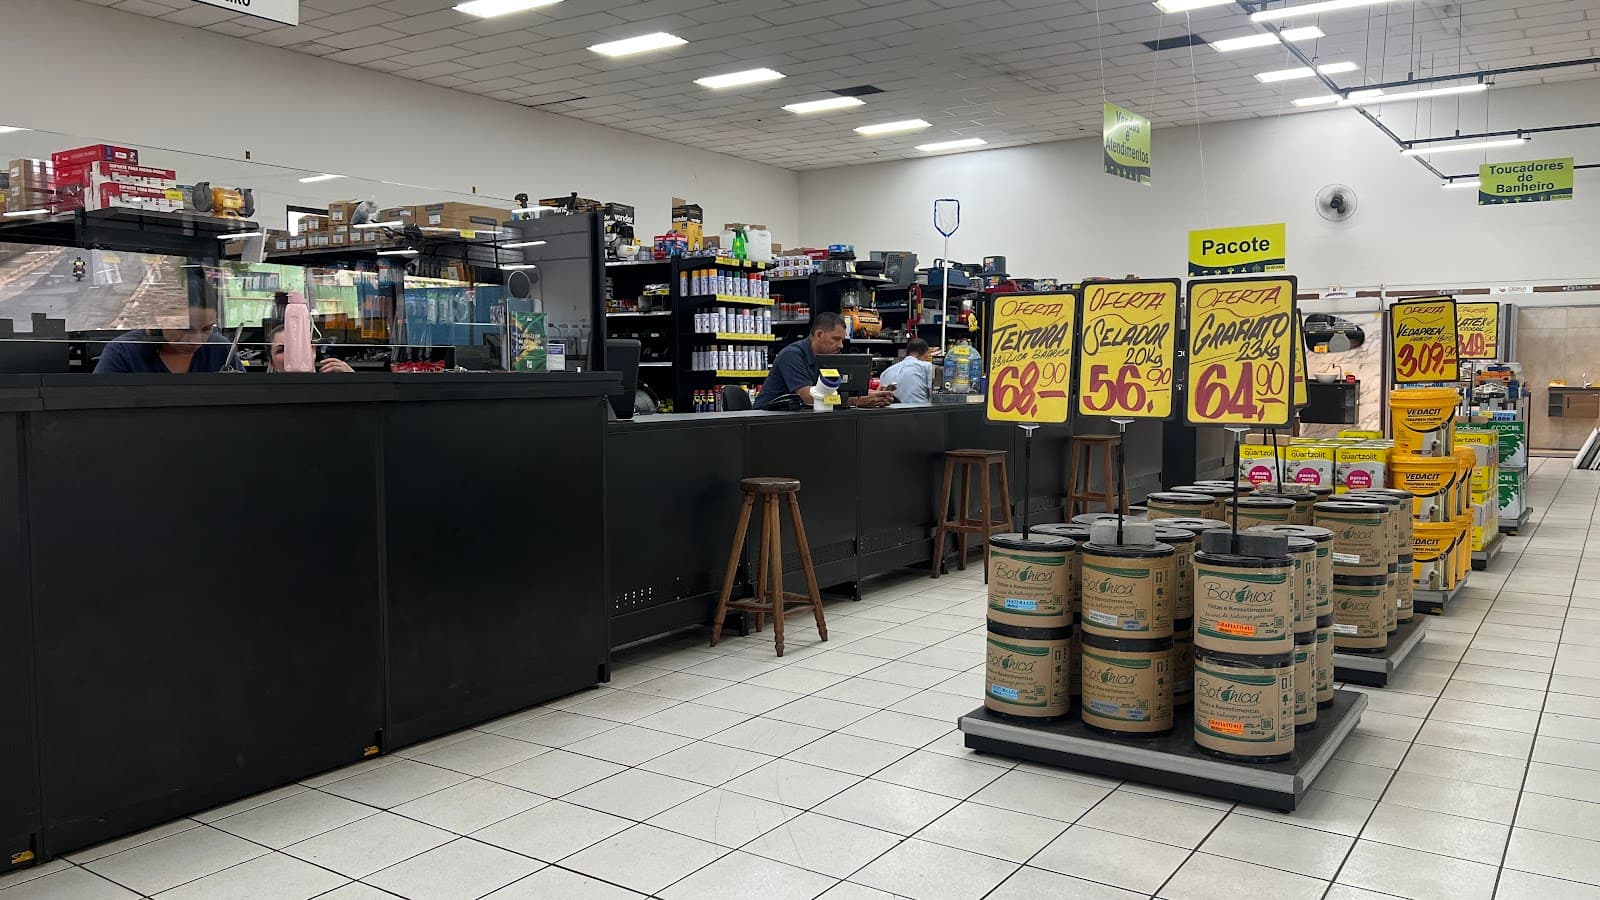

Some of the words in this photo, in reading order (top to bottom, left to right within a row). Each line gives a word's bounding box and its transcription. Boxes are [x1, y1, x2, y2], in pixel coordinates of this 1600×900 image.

[1106, 137, 1149, 163] Atendimentos
[1489, 162, 1564, 174] Toucadores
[1517, 173, 1533, 182] de
[1496, 182, 1554, 193] Banheiro
[614, 214, 633, 223] vonder
[1202, 237, 1270, 255] Pacote
[1089, 288, 1166, 311] OFERTA
[1196, 286, 1282, 308] OFERTA
[1000, 300, 1064, 317] OFERTA
[1403, 305, 1445, 315] OFERTA
[1457, 317, 1488, 328] LATEX
[1192, 312, 1290, 356] GRAFIATO
[1396, 323, 1446, 338] VEDAPREN
[993, 321, 1069, 354] TEXTURA
[1083, 319, 1170, 356] SELADOR
[1244, 449, 1275, 458] quartzoli
[1291, 450, 1326, 459] quartzolit
[1341, 452, 1377, 460] quartzolit
